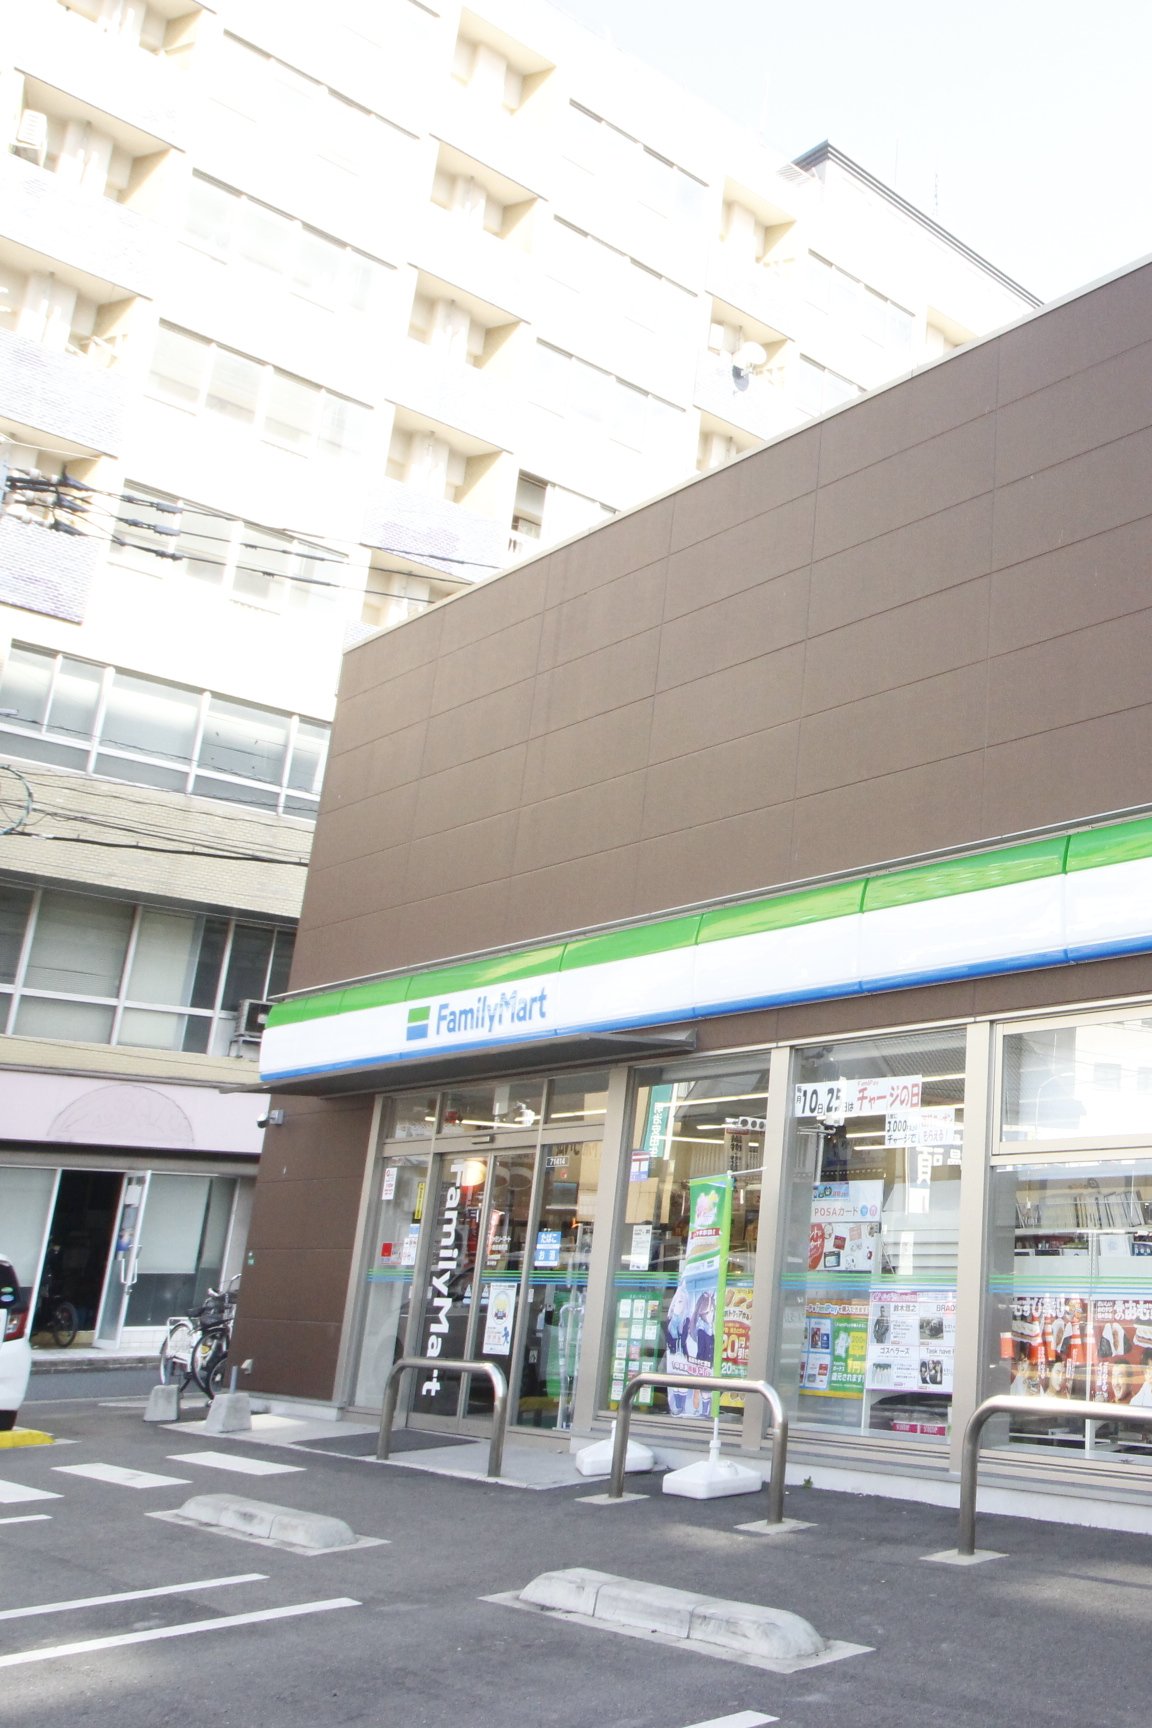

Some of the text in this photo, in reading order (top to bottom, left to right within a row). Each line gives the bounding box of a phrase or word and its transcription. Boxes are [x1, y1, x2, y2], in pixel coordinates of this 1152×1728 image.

[436, 986, 547, 1035] FamilyMart
[857, 1083, 922, 1111] チャージの日
[814, 1206, 859, 1217] POSAカード
[422, 1159, 464, 1397] FamilyMat
[880, 1347, 910, 1355] ゴスペラーズ
